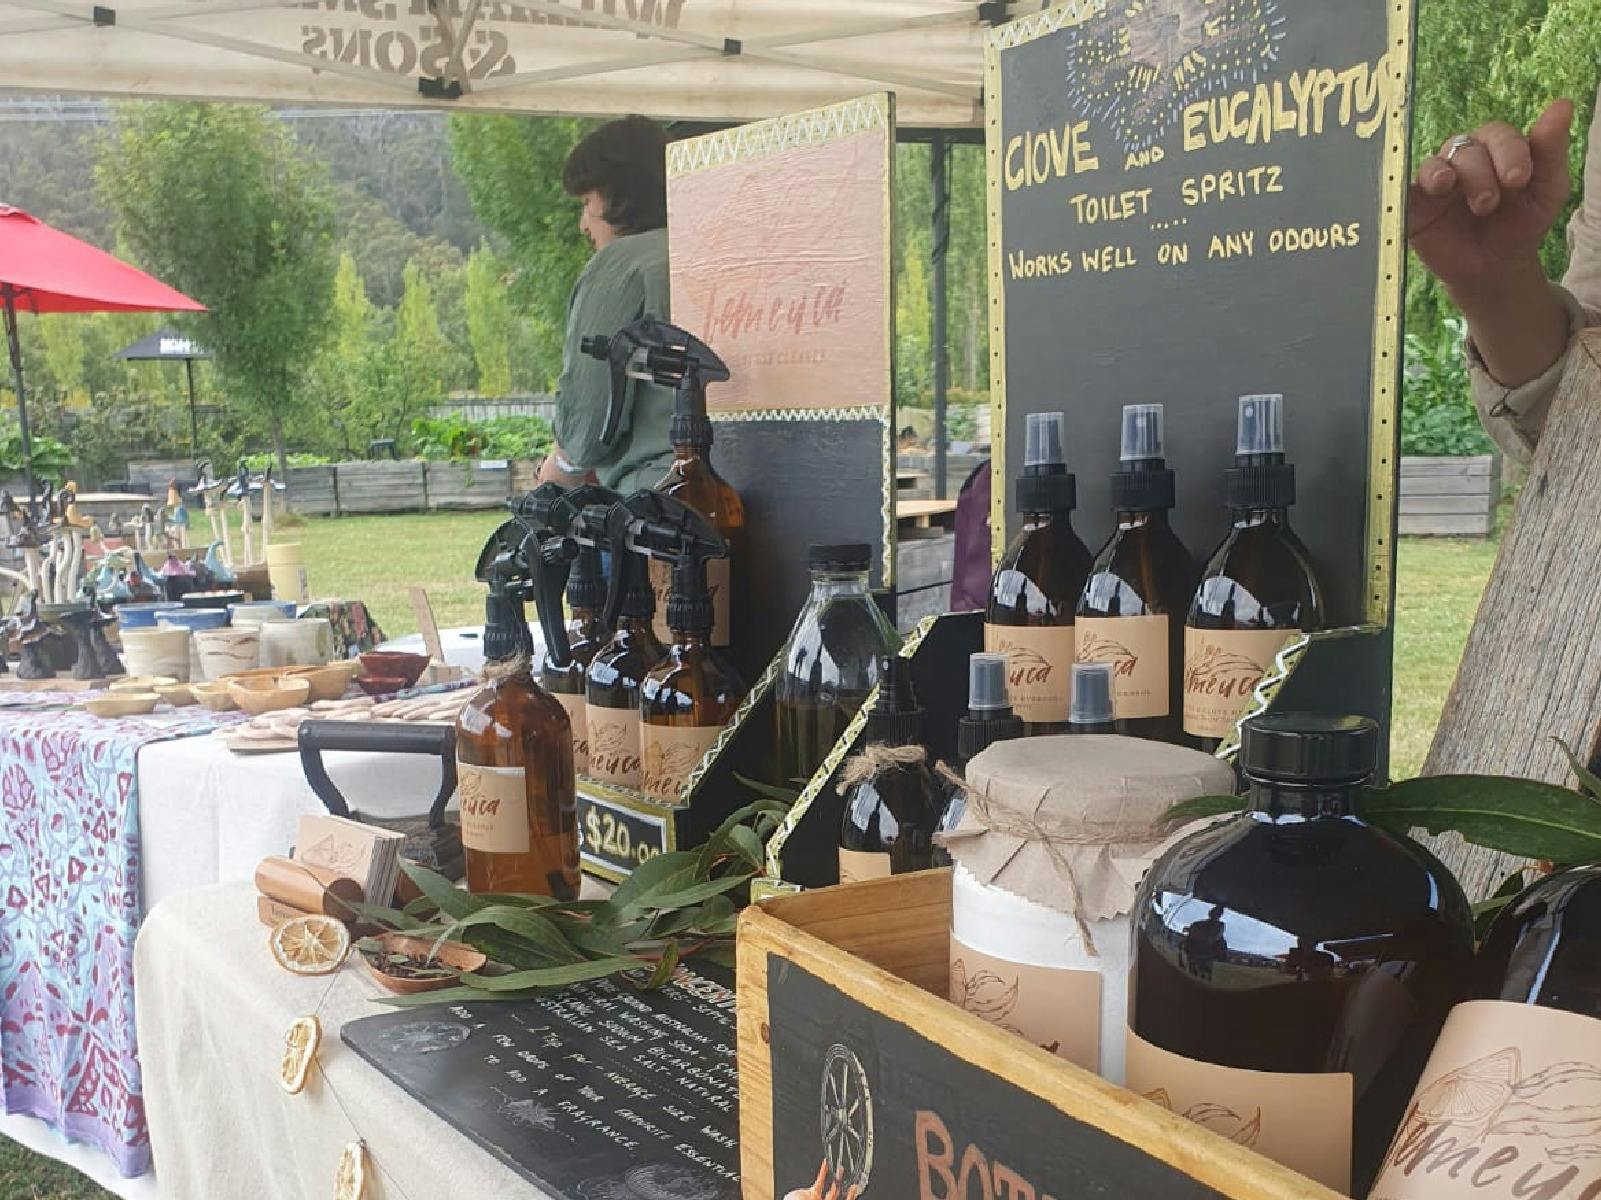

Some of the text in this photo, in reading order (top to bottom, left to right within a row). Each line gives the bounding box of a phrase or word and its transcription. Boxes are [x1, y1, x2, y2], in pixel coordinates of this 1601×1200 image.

[1124, 147, 1165, 170] AND
[1070, 165, 1283, 224] TOILET SPRITZ
[1081, 246, 1137, 272] WELL
[1157, 242, 1188, 265] ON
[1208, 231, 1254, 259] ANY
[1269, 222, 1360, 252] ODOURS
